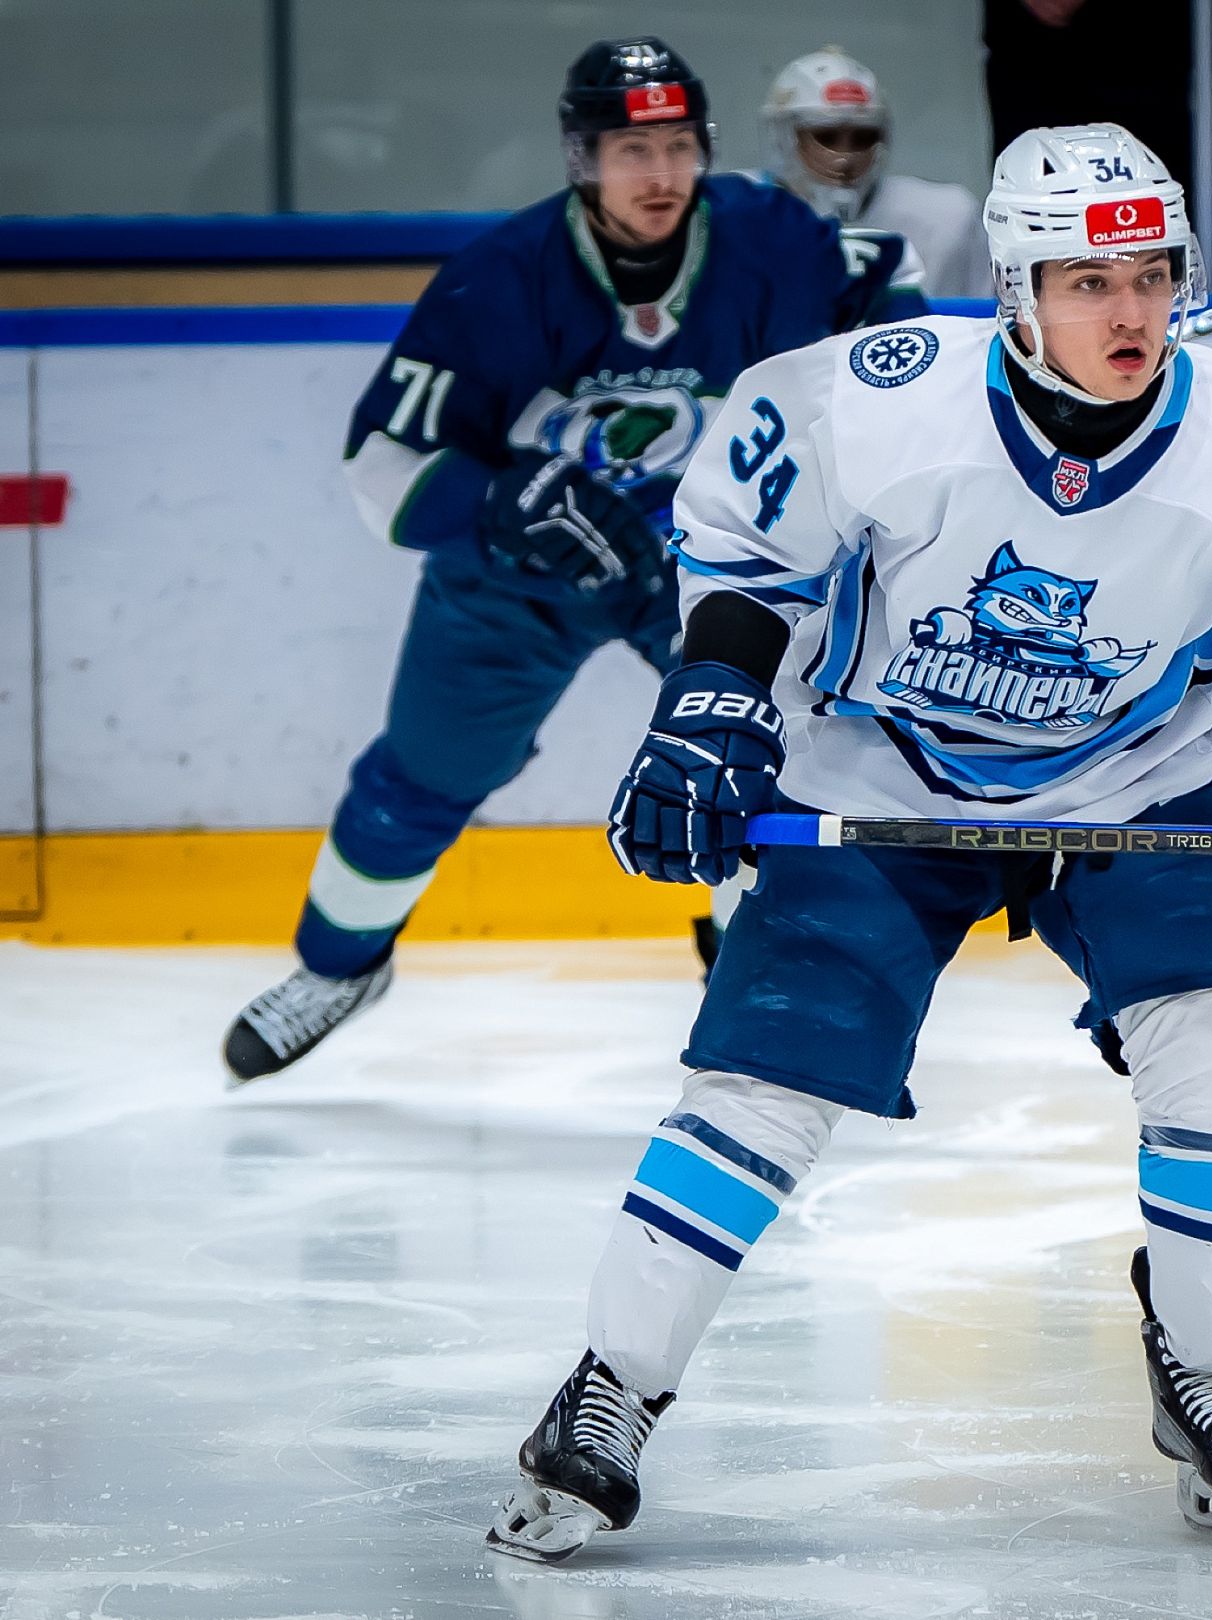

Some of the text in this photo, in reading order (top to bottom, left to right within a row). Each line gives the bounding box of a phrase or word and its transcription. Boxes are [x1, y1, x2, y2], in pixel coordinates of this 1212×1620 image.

[1088, 156, 1133, 183] 34
[1092, 225, 1162, 244] OLIMPBET
[387, 356, 455, 441] 71
[729, 396, 800, 534] 34
[671, 691, 787, 750] BAU
[952, 826, 1158, 851] RIBCOR
